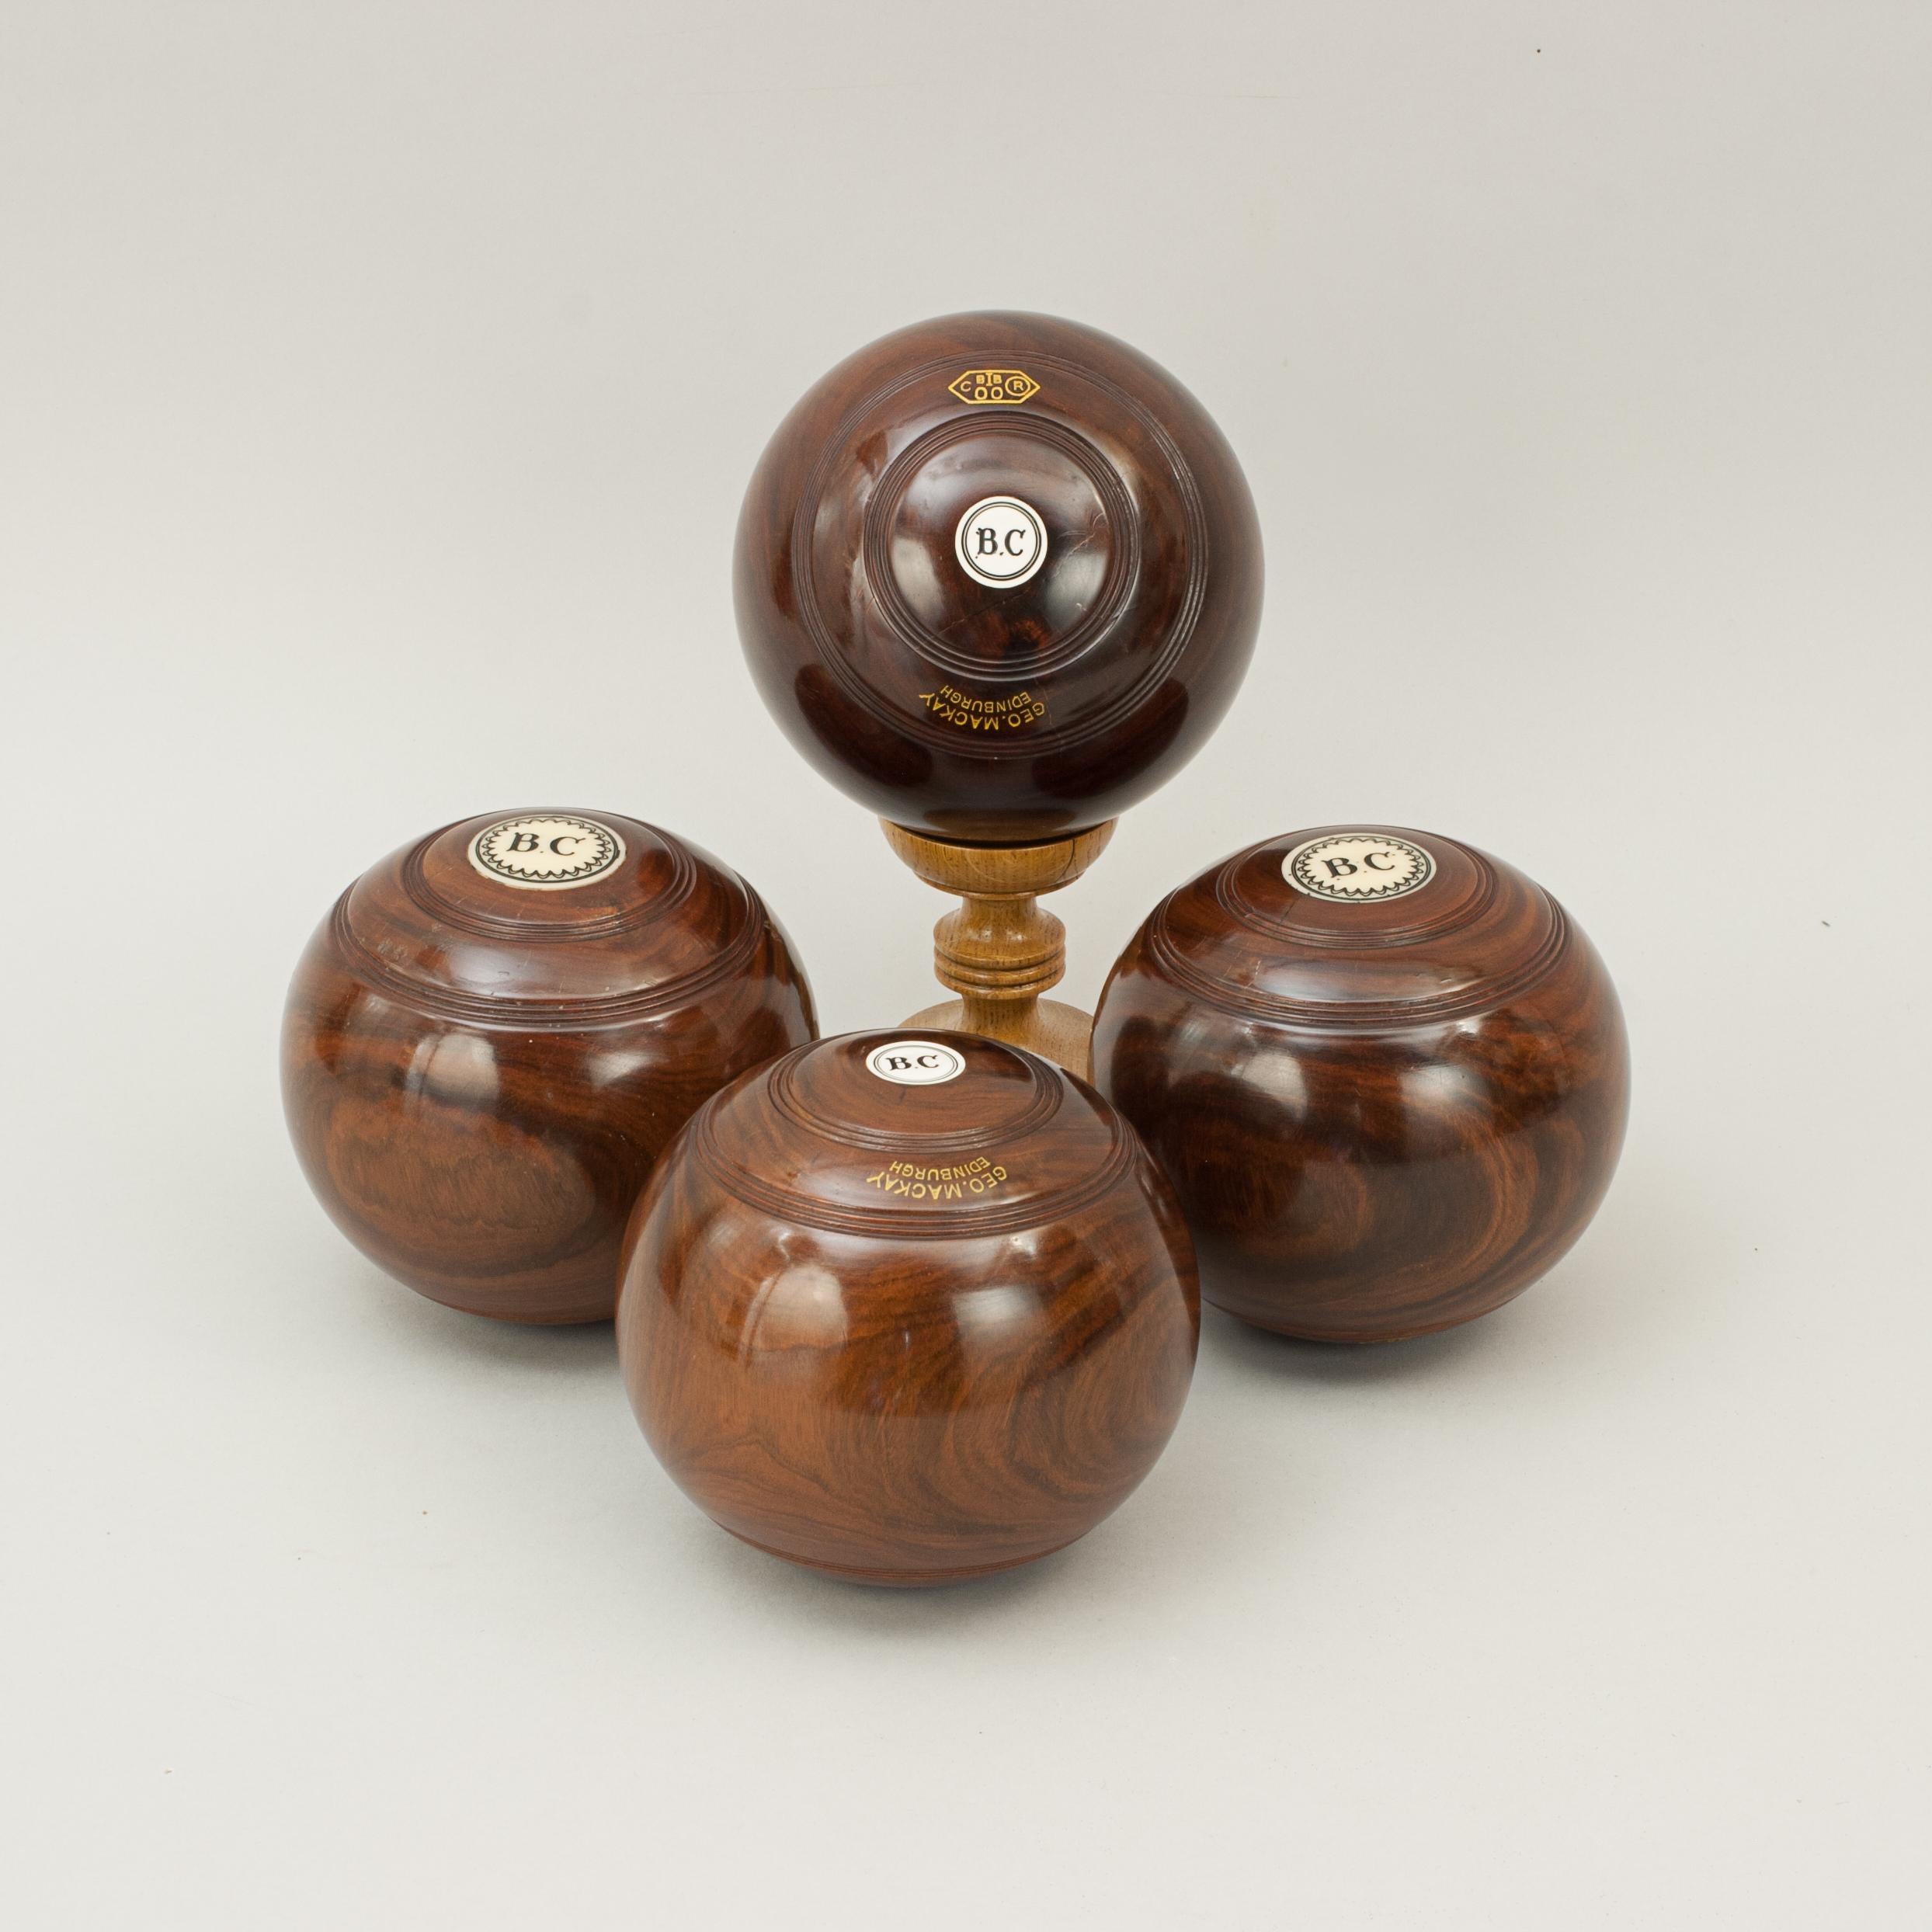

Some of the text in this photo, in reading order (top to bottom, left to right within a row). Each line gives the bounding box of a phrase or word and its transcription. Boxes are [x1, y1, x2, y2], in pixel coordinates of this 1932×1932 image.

[960, 380, 971, 392] C
[975, 527, 1026, 558] B.C
[940, 685, 1032, 714] EDINBURGH
[506, 832, 586, 857] B.C
[885, 1055, 940, 1071] B.C
[889, 1156, 991, 1181] EDINBURGH
